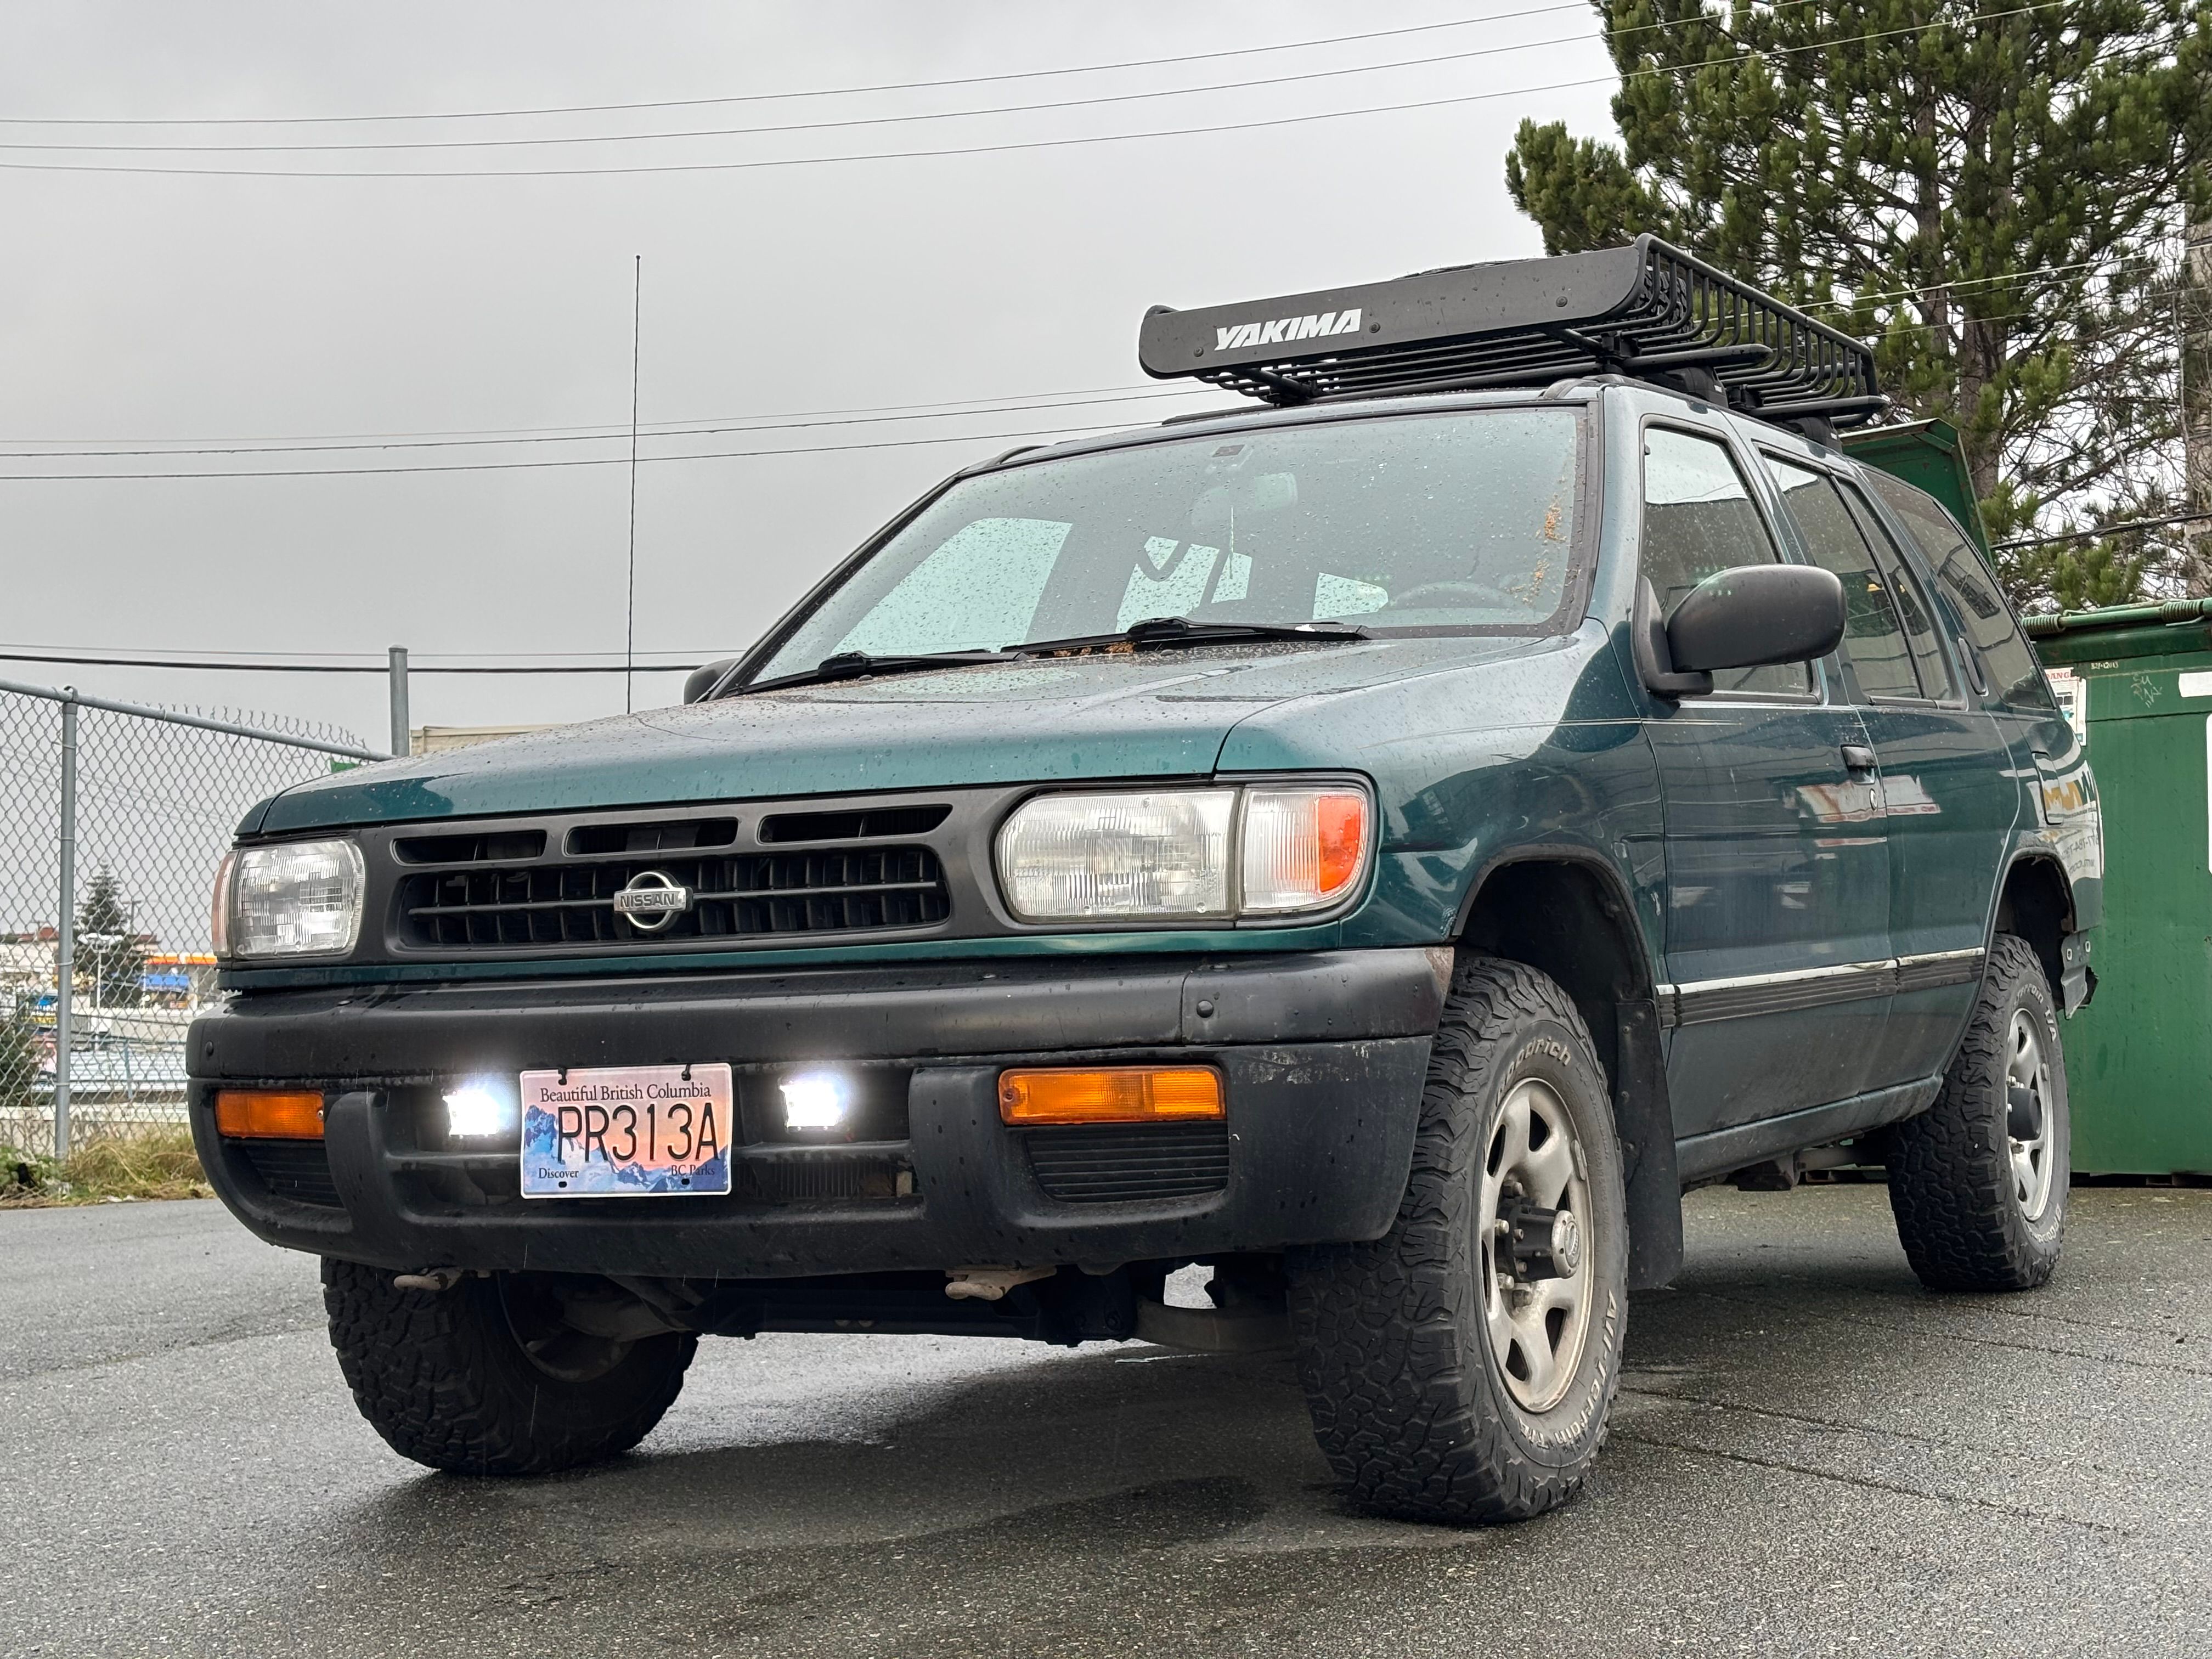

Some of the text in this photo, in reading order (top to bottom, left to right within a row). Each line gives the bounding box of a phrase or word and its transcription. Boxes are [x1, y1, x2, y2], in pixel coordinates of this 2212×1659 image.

[1214, 308, 1362, 351] YAKIMA
[620, 893, 675, 908] NISSAN
[540, 1081, 712, 1103] Beautiful British Columbia
[557, 1102, 719, 1164] PR313A
[538, 1167, 579, 1179] Discover
[671, 1164, 715, 1176] BC Parks
